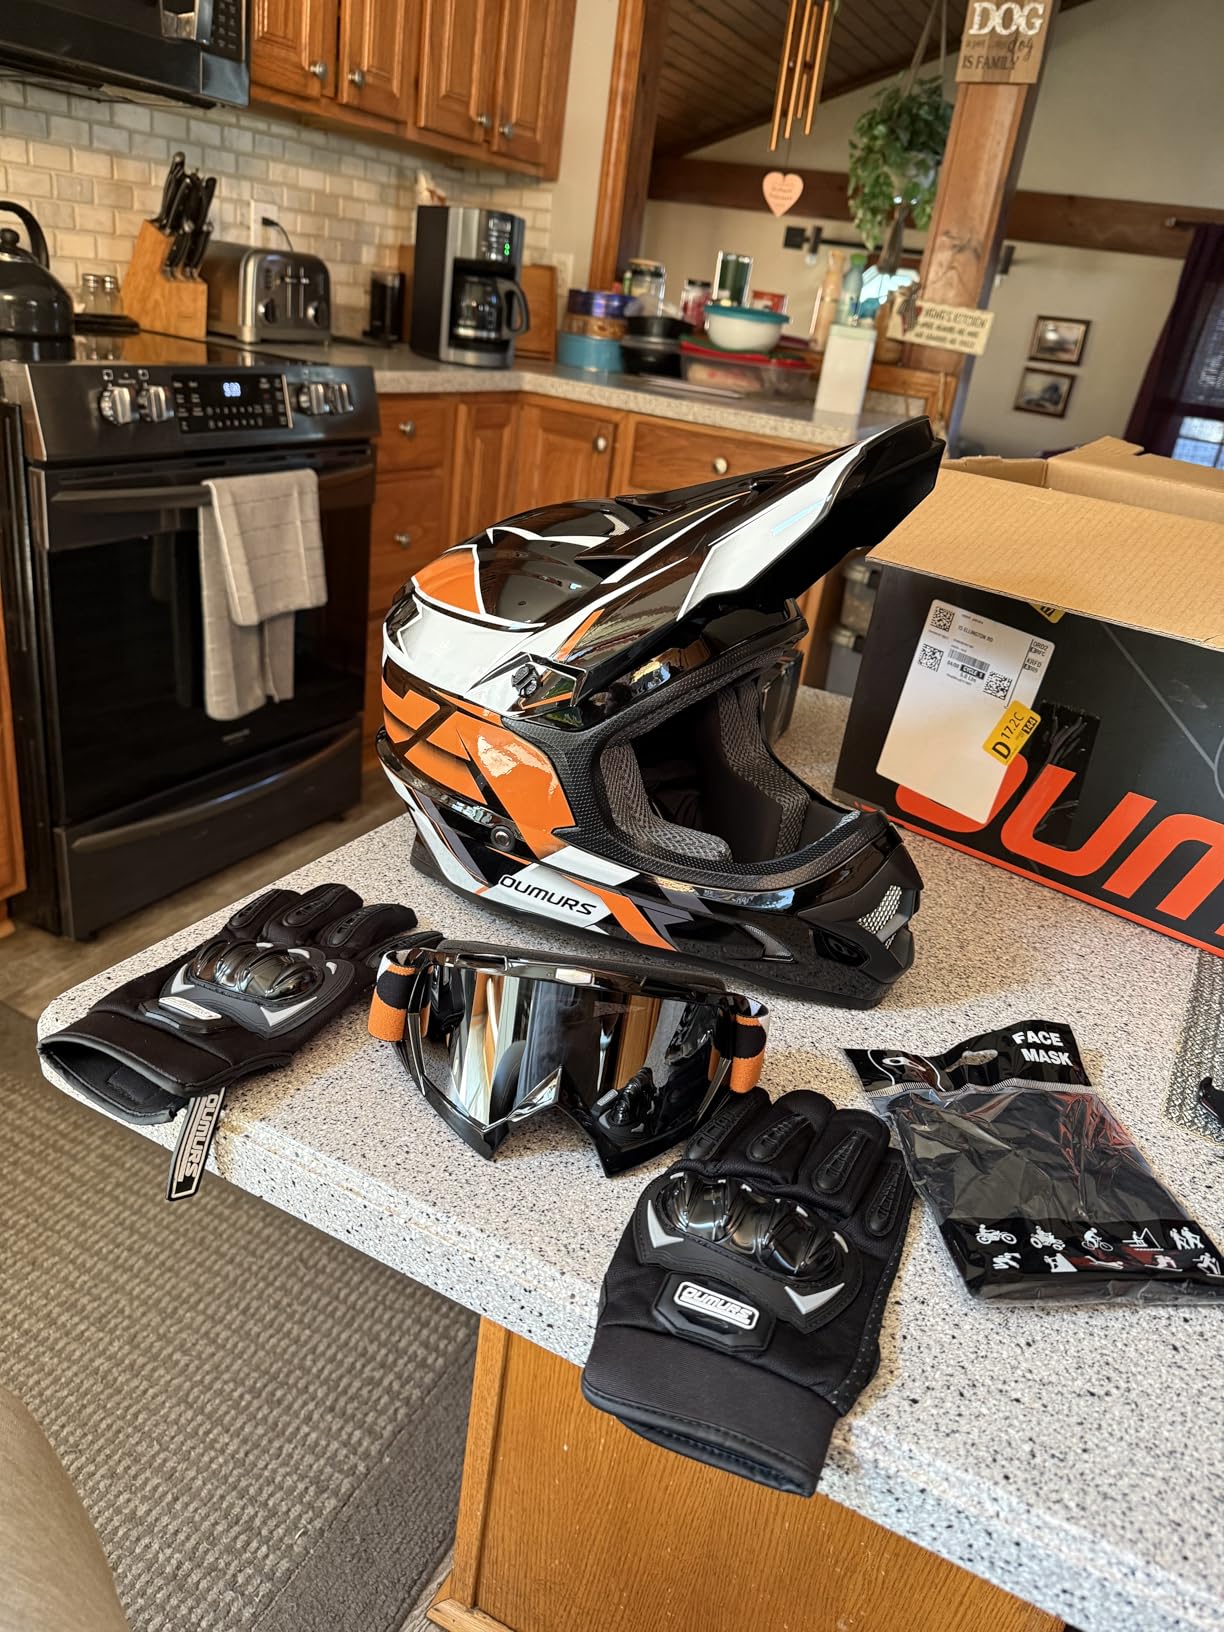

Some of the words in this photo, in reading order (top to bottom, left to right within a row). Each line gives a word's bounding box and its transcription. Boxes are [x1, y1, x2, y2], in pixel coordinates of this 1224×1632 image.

[968, 2, 1044, 35] DOG
[961, 55, 974, 69] IS
[975, 55, 1019, 70] FAMILY
[1000, 711, 1024, 739] 17.2C
[1022, 717, 1037, 733] 144
[992, 741, 1011, 760] D
[499, 875, 597, 915] OUMURS
[1012, 1030, 1064, 1046] FACE
[1021, 1048, 1074, 1067] MASK
[184, 1093, 219, 1178] OUMURS
[680, 1286, 753, 1325] OUMURS
